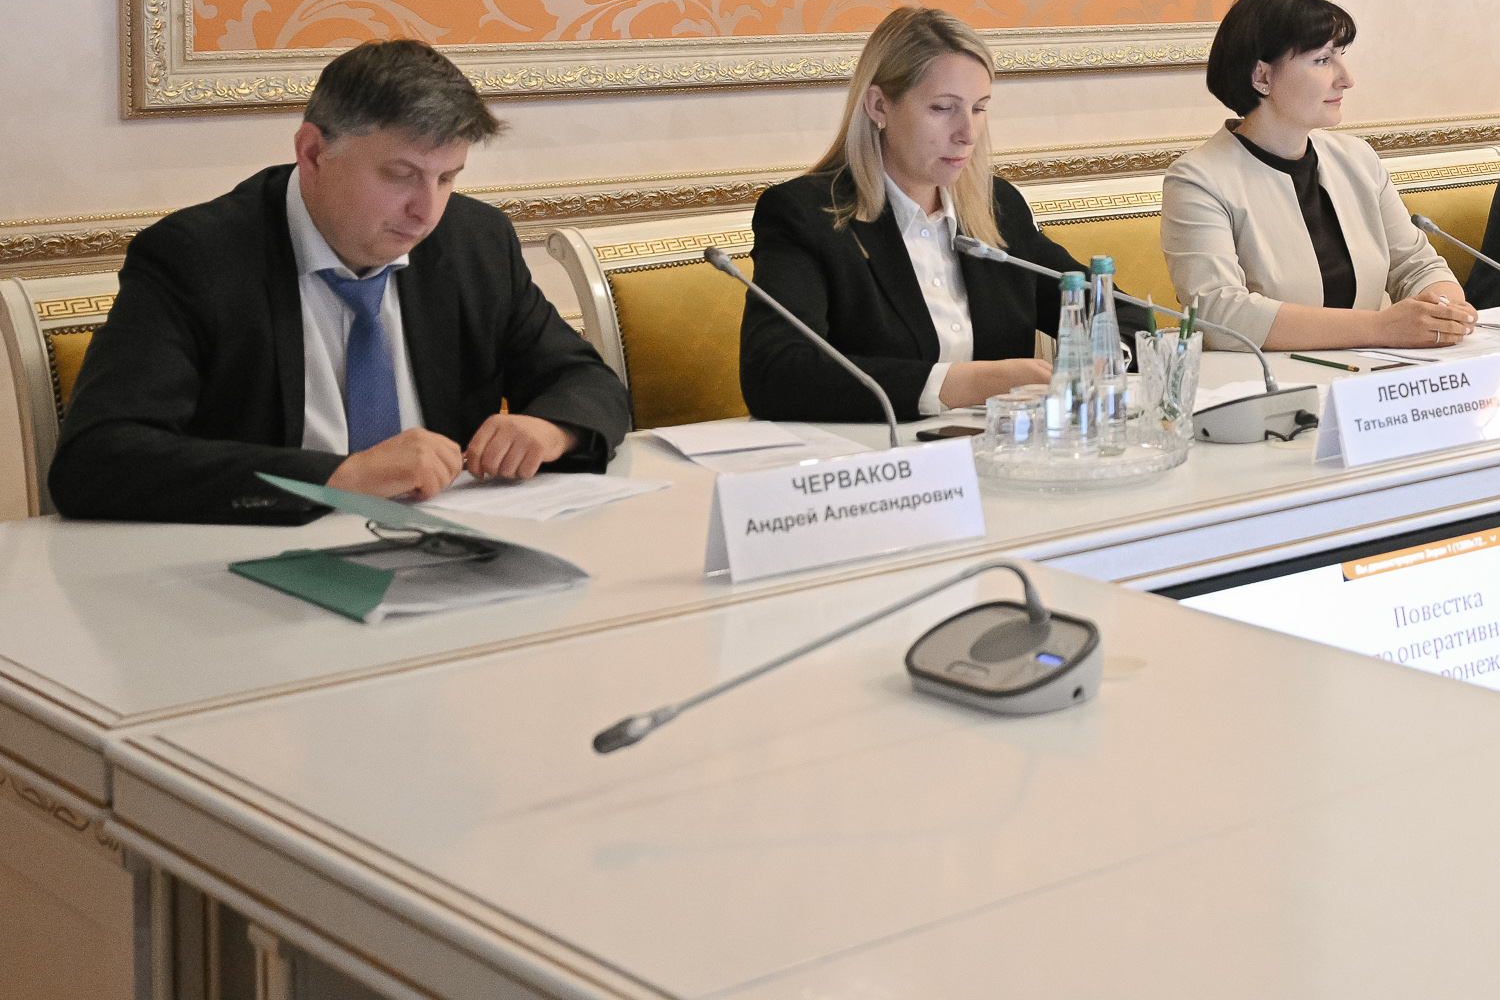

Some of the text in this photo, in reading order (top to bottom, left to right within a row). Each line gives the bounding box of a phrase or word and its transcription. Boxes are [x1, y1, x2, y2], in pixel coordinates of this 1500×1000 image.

[1378, 372, 1471, 402] ЛЕОНТЬЕВА
[1355, 396, 1500, 433] Татьяна Вячеславовна
[792, 460, 913, 495] ЧЕРВАКОВ
[746, 486, 964, 536] Андрей Александрович
[1393, 591, 1484, 628] Повестка
